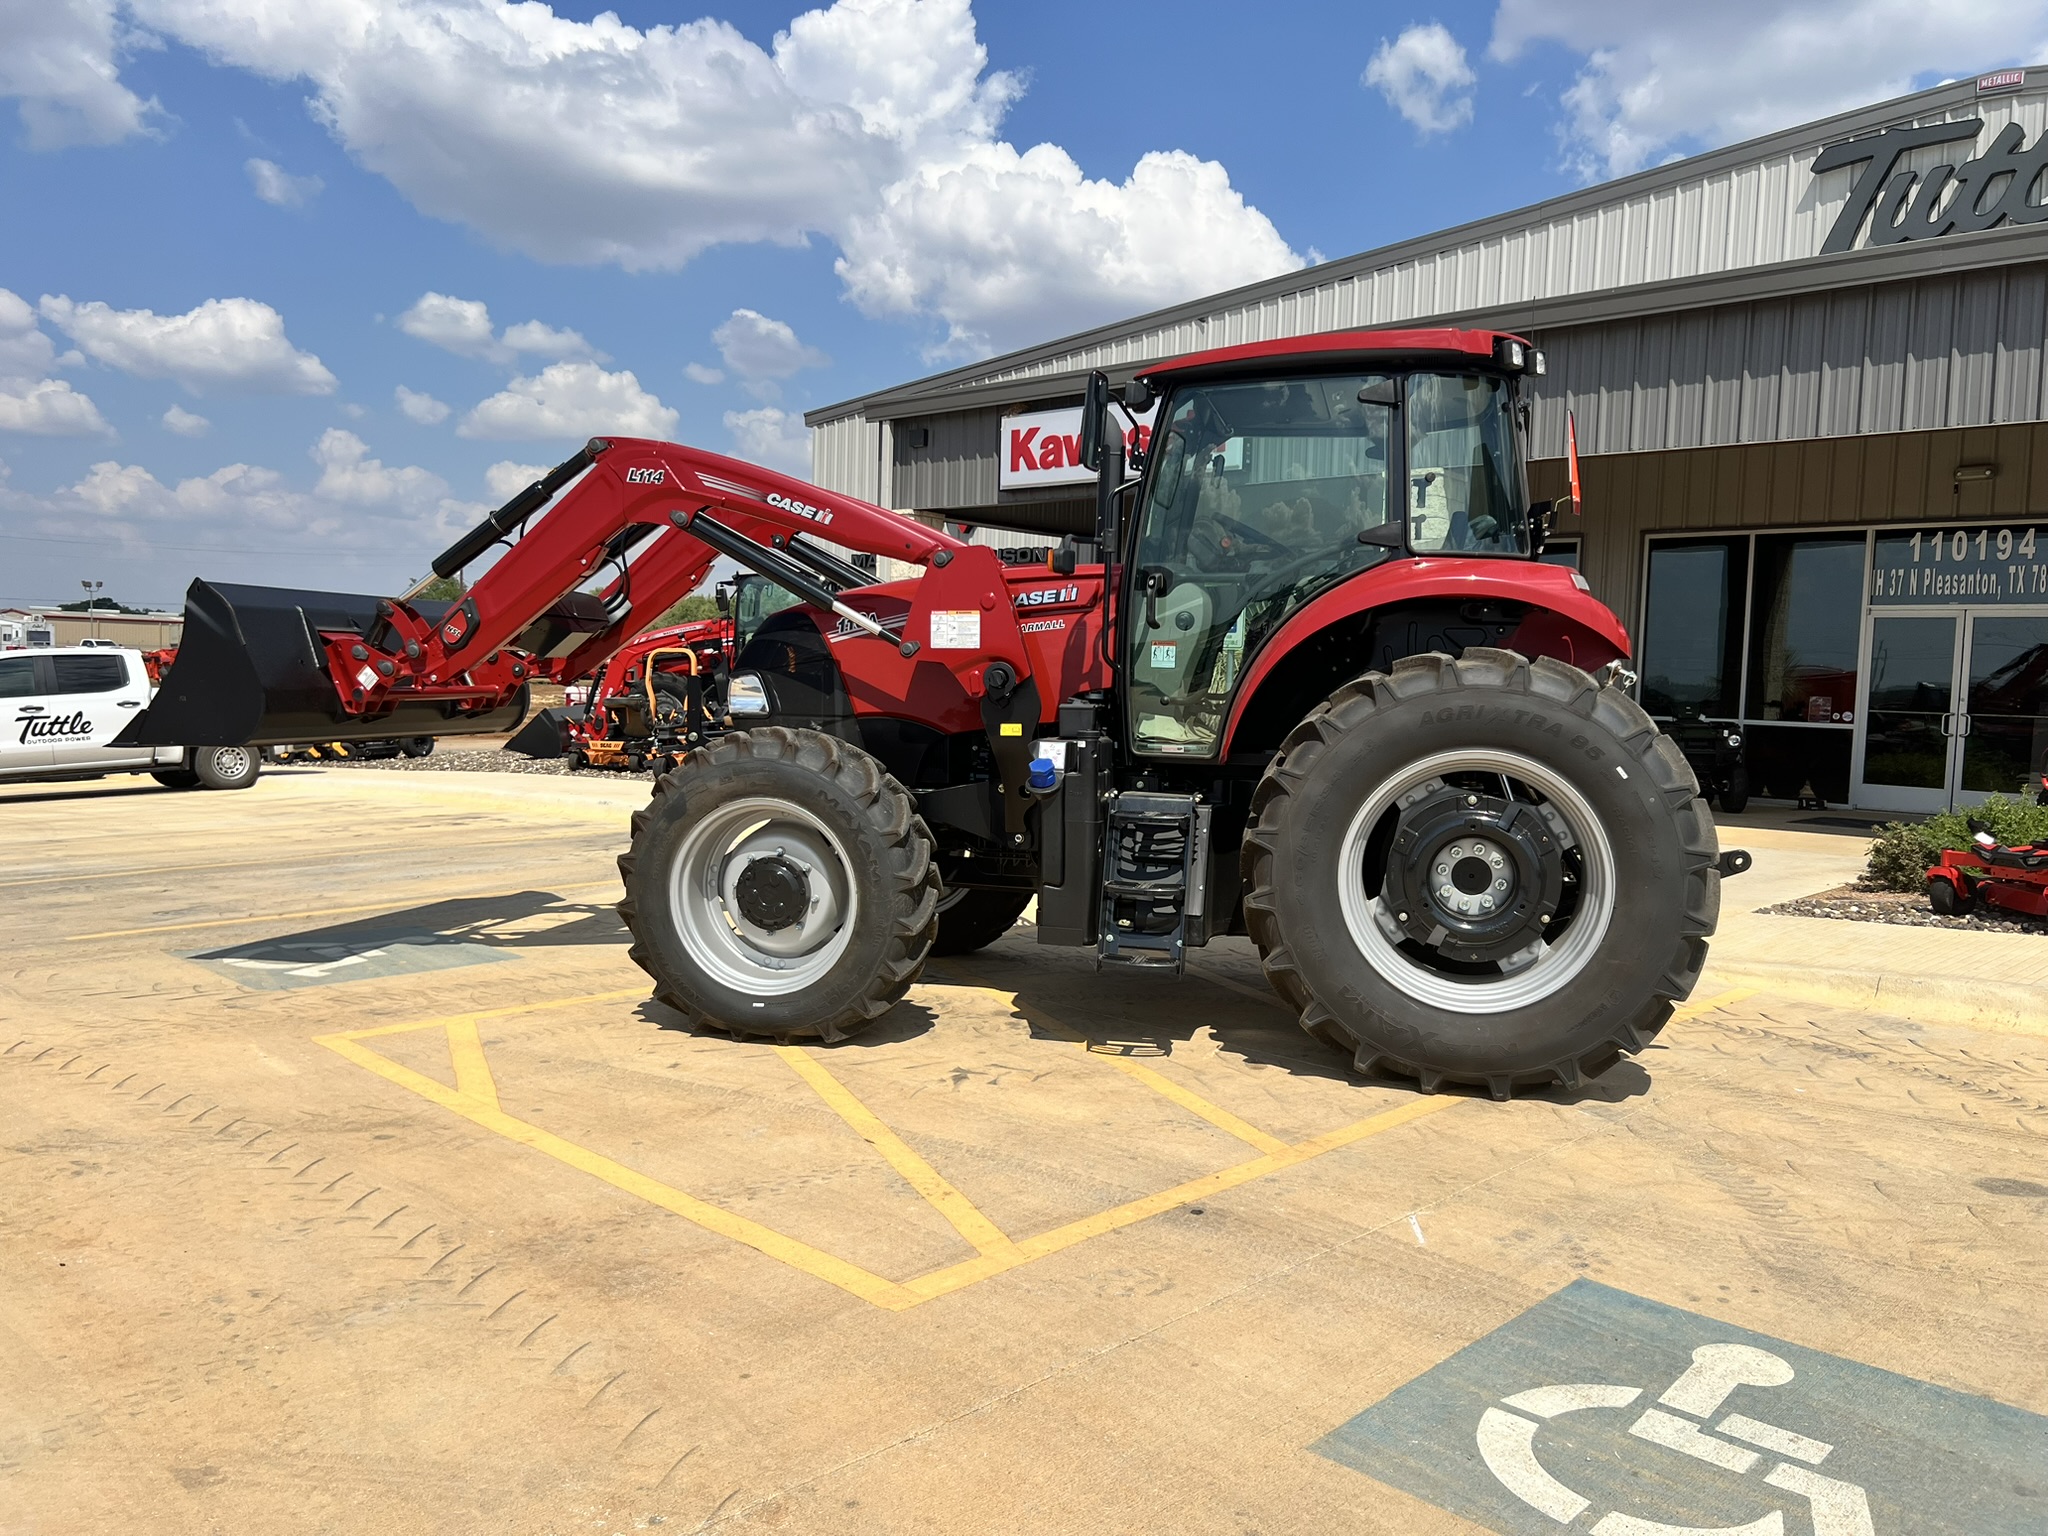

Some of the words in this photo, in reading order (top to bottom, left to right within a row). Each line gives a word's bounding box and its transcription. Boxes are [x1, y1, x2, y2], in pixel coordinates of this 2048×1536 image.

[1981, 73, 2020, 87] METALLIC
[627, 468, 665, 485] L114
[766, 493, 816, 519] CASE
[1909, 528, 2036, 562] 110194
[1889, 568, 1904, 596] 37
[1909, 568, 1918, 596] N
[1923, 567, 2001, 601] Pleasanton,
[2008, 565, 2026, 594] TX
[2032, 564, 2048, 593] 78
[1015, 590, 1057, 606] ASE
[1021, 619, 1065, 633] ARMALL
[15, 711, 94, 745] Tuttle
[1569, 733, 1606, 761] 85
